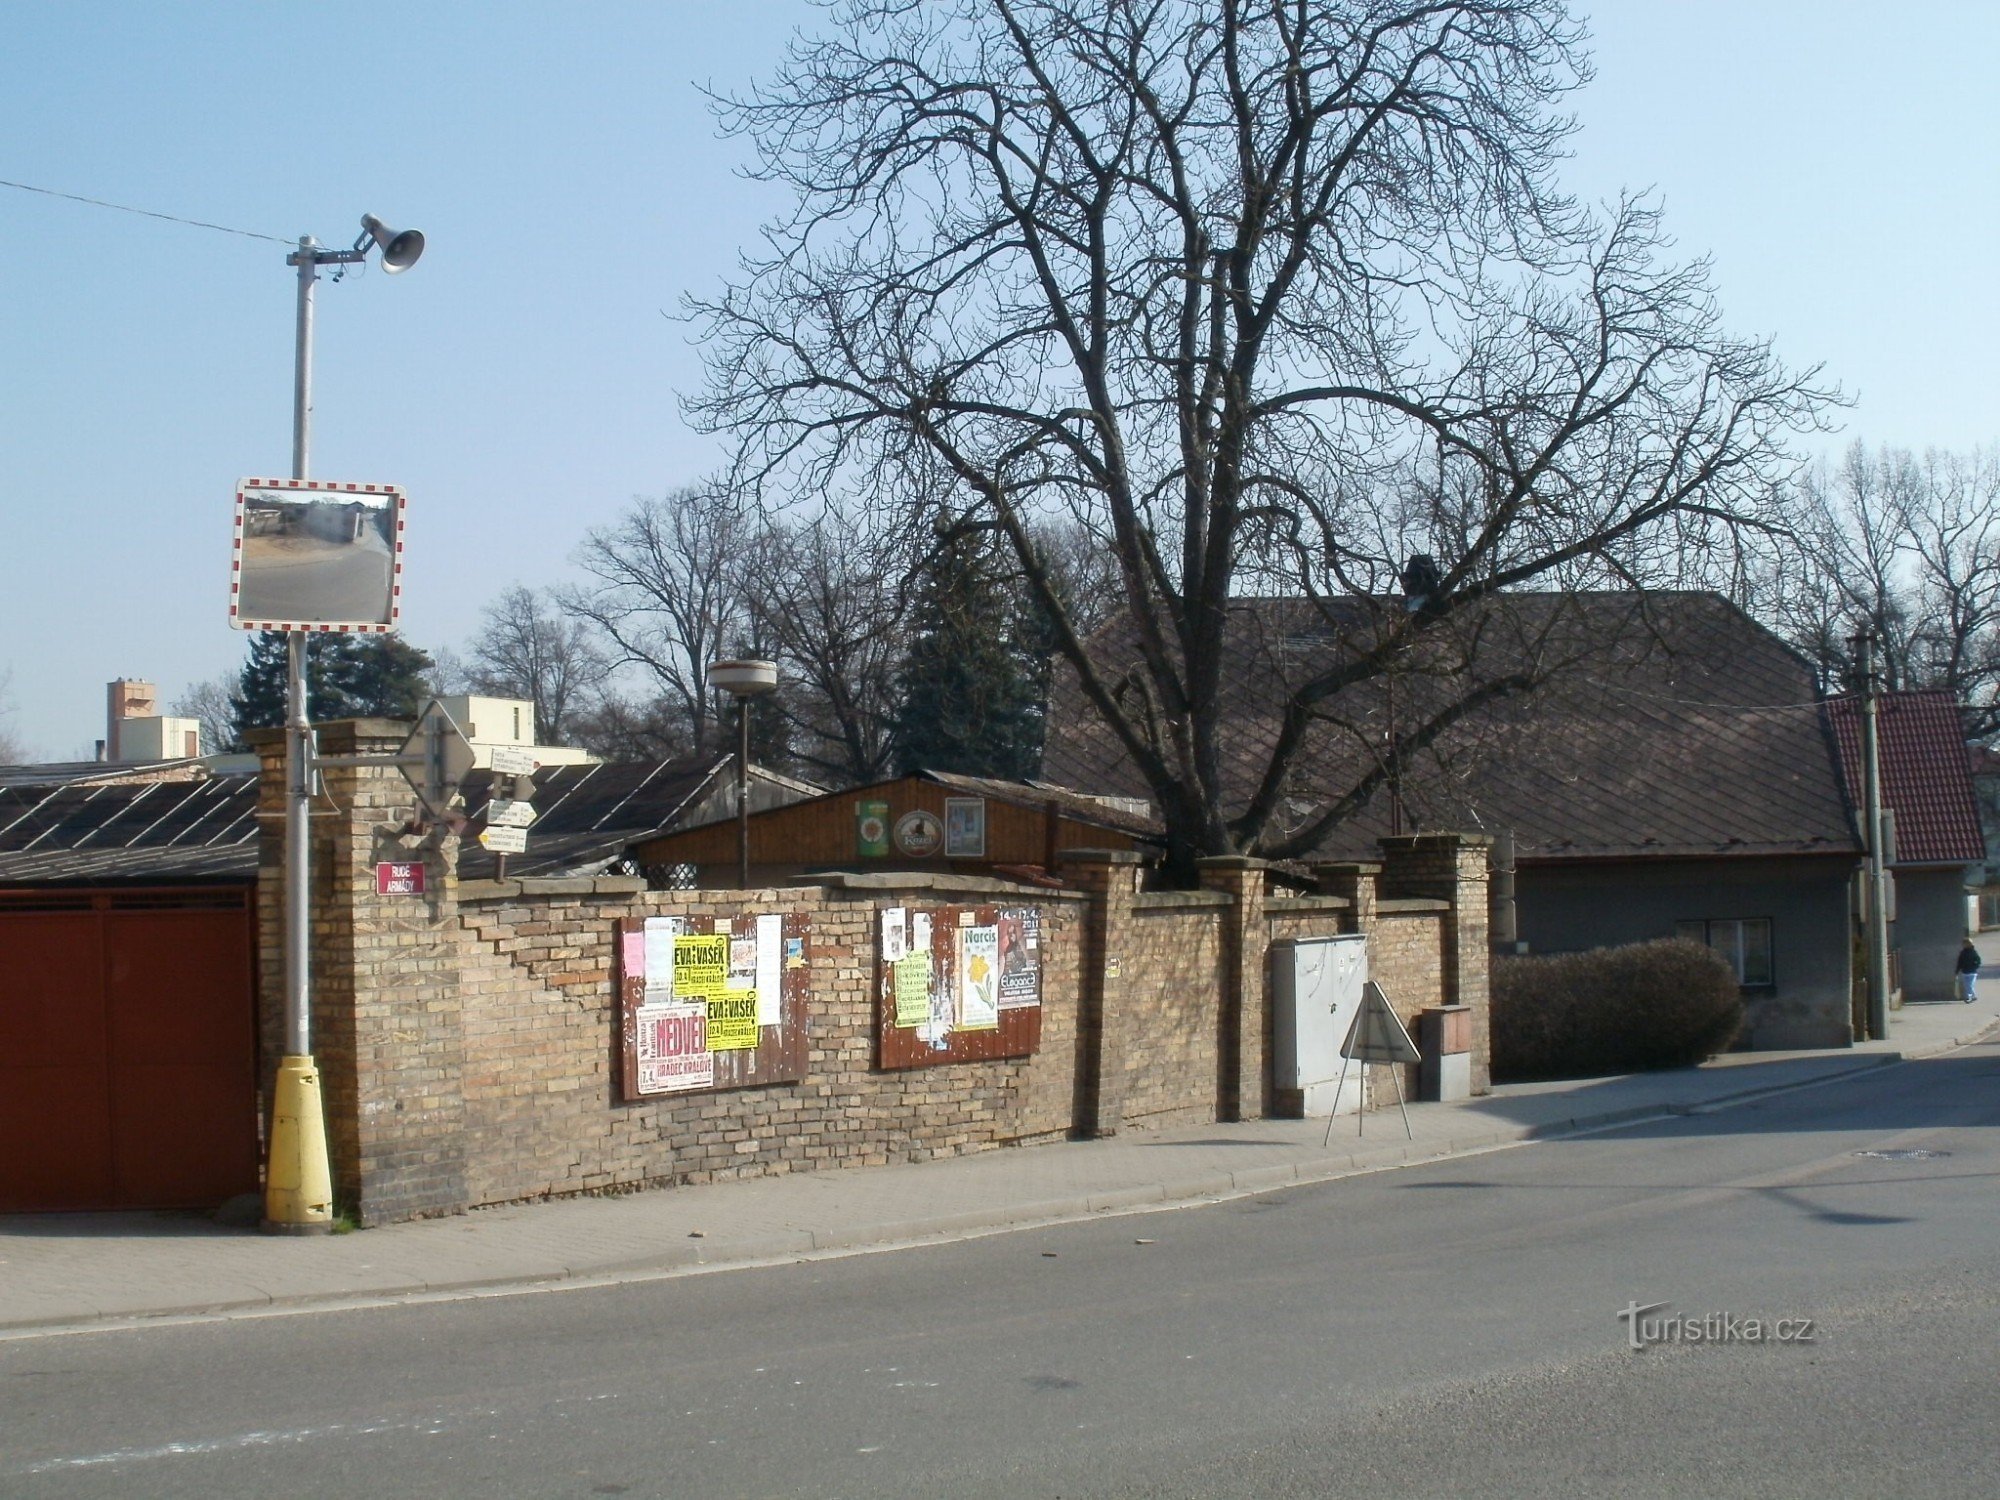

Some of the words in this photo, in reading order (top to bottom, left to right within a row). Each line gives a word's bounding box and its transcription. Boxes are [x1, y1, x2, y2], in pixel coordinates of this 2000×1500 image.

[391, 865, 411, 878] RUDÉ
[387, 879, 414, 893] ARMÁDY
[1022, 920, 1039, 929] 2011
[965, 929, 996, 944] Narcis
[674, 947, 692, 966] EVA
[696, 944, 725, 965] VAŠEK
[708, 1001, 724, 1019] EVA
[728, 998, 756, 1018] VAŠEK
[657, 1062, 683, 1077] HRADEC
[684, 1058, 712, 1075] KRÁLOVÉ
